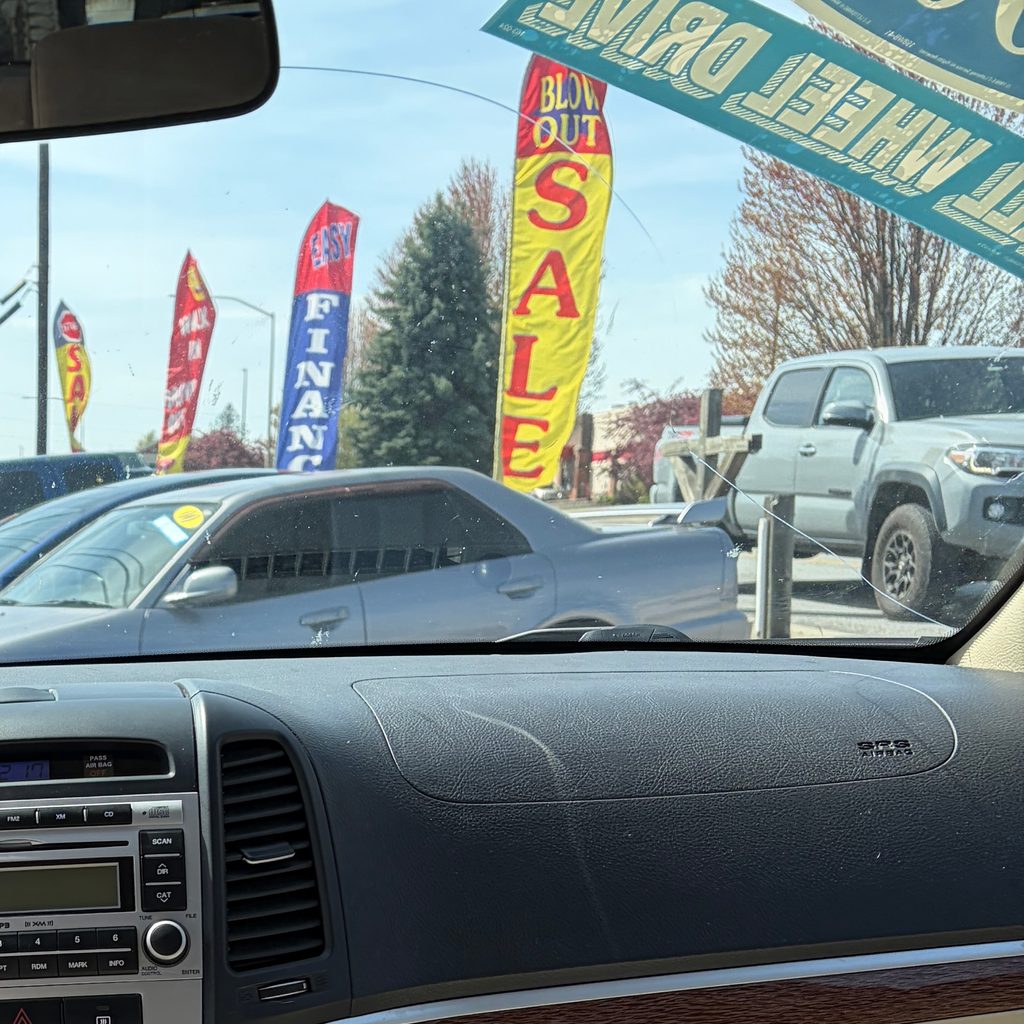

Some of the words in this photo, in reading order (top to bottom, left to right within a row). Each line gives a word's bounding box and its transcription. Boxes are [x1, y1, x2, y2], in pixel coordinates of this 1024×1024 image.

[540, 73, 601, 113] BLOW
[532, 113, 602, 149] OUT
[310, 222, 353, 269] EASY
[502, 160, 588, 478] SALE
[89, 754, 108, 762] PASS
[151, 837, 172, 845] SCAN
[156, 868, 169, 876] DIR
[156, 891, 172, 900] CAT
[34, 937, 41, 945] 4
[74, 935, 80, 943] 5
[112, 934, 118, 942] 6
[68, 960, 88, 969] MARK
[108, 959, 125, 967] INFO
